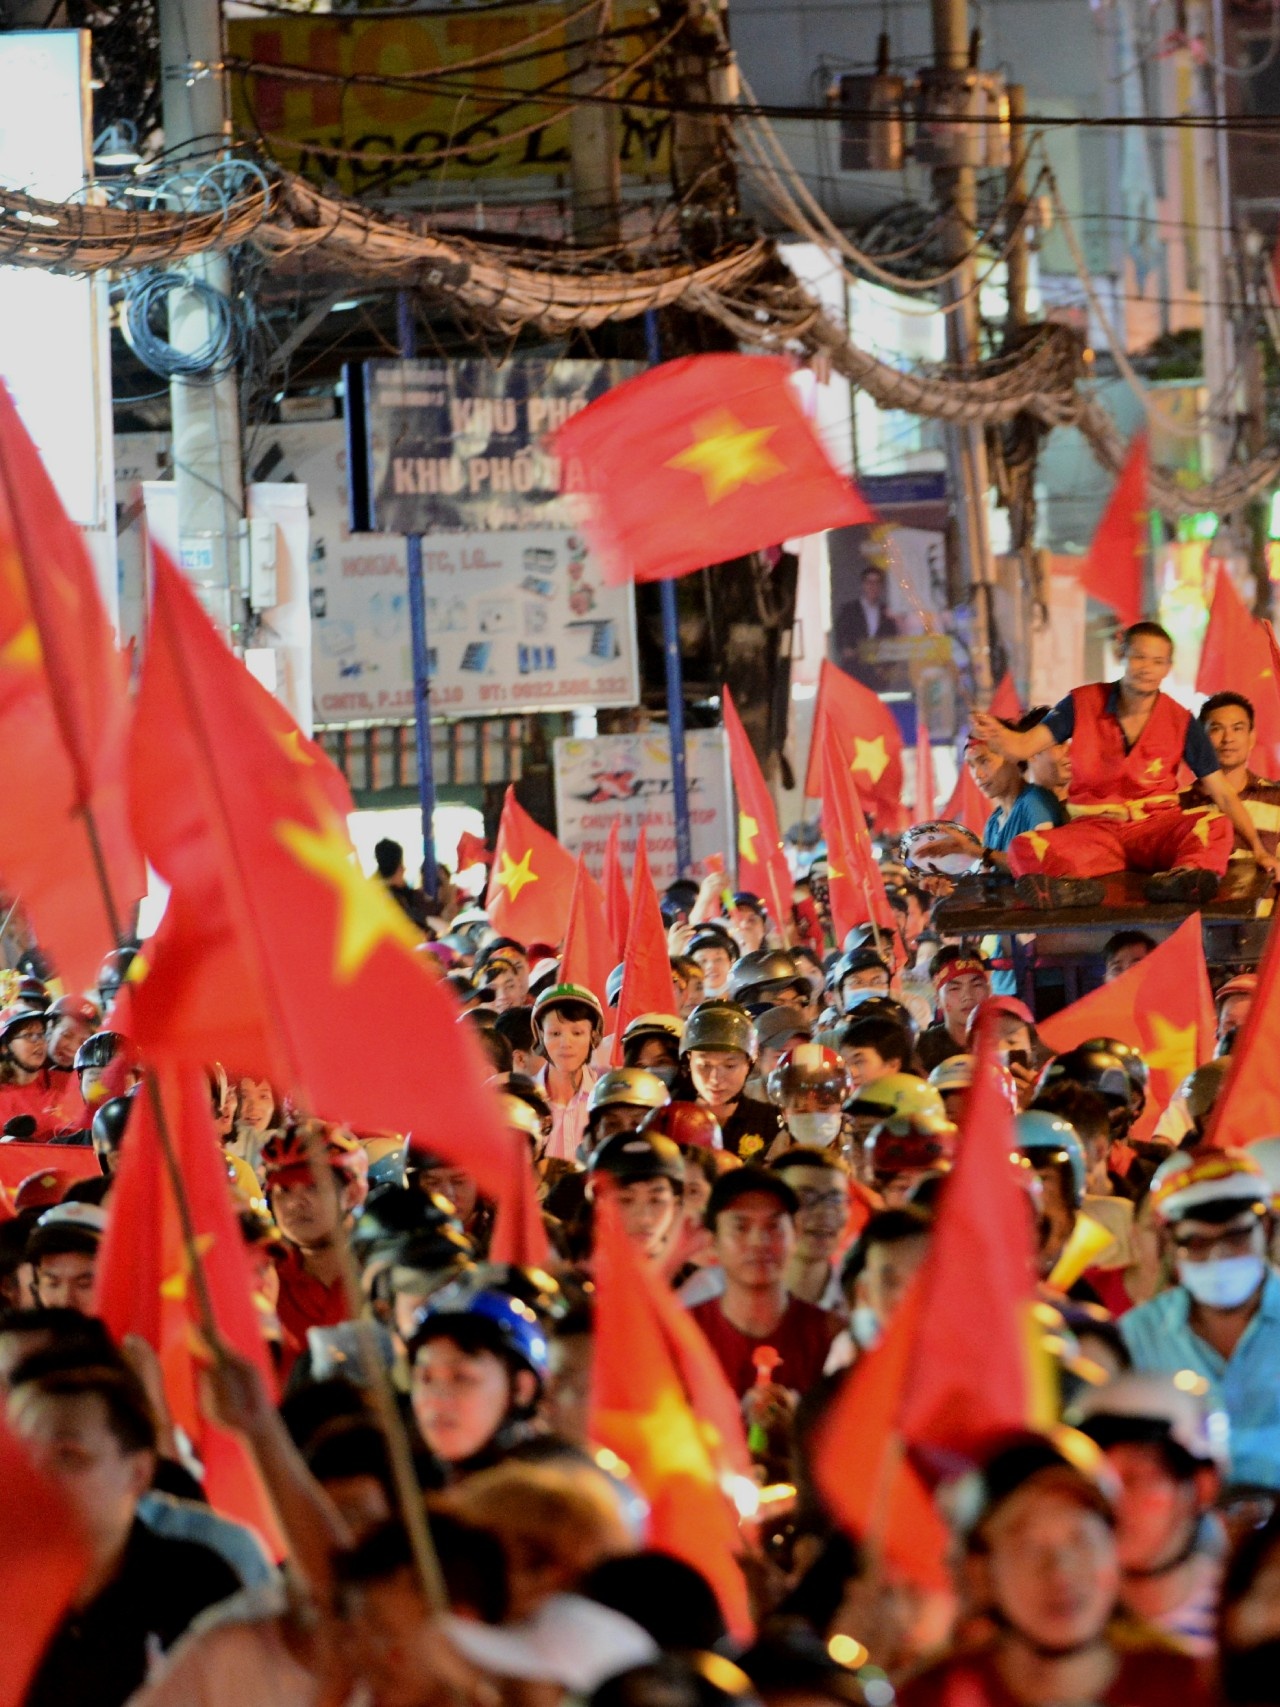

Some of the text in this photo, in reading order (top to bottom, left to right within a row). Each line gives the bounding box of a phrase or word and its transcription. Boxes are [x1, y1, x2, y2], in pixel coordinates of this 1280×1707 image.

[520, 115, 672, 163] LM
[451, 397, 518, 435] KHU
[393, 456, 463, 495] KHU
